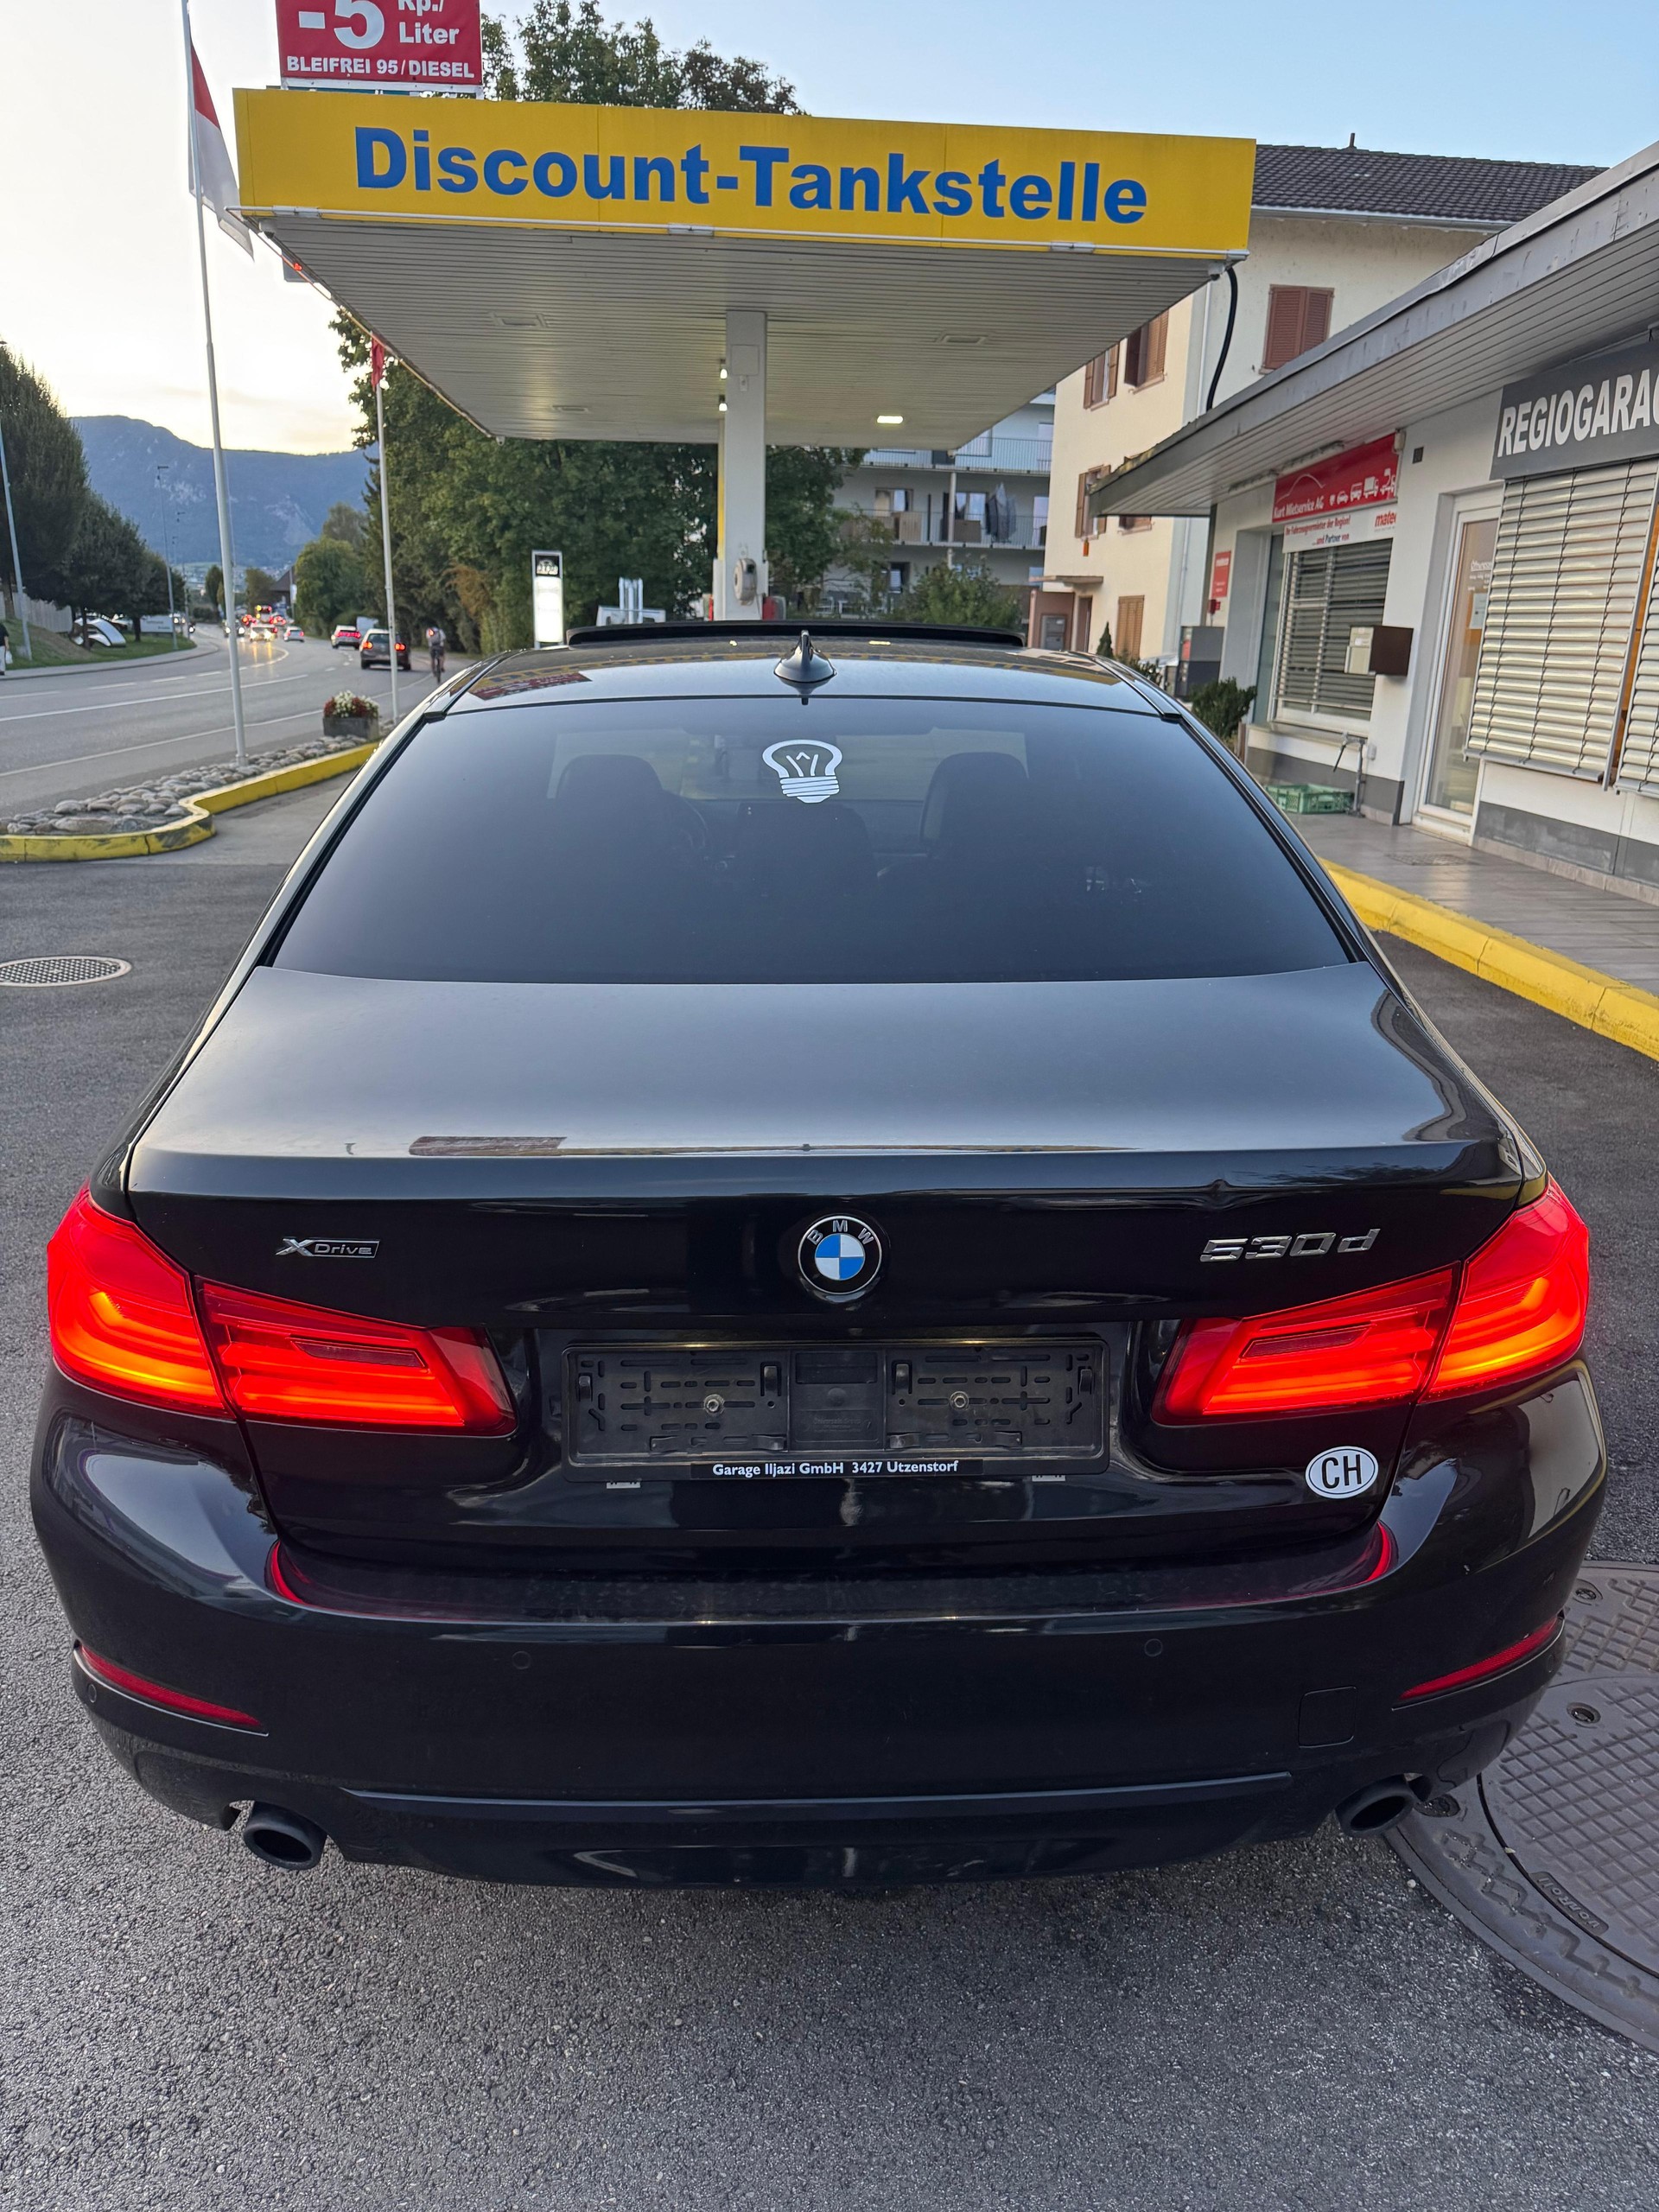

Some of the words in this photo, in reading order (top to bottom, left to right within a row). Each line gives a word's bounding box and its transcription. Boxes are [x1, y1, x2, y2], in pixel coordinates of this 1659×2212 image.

[398, 22, 460, 44] Liter
[287, 56, 371, 74] BLEIFREI
[355, 126, 1147, 224] Discount-Tankstelle
[807, 1219, 874, 1245] BMW
[1199, 1228, 1381, 1262] 530d
[713, 1464, 760, 1478] Garage
[765, 1462, 796, 1478] Iljazi
[799, 1462, 844, 1475] GmbH
[852, 1461, 883, 1473] 3427
[887, 1460, 958, 1473] Utzenstorf
[1321, 1453, 1362, 1490] CH
